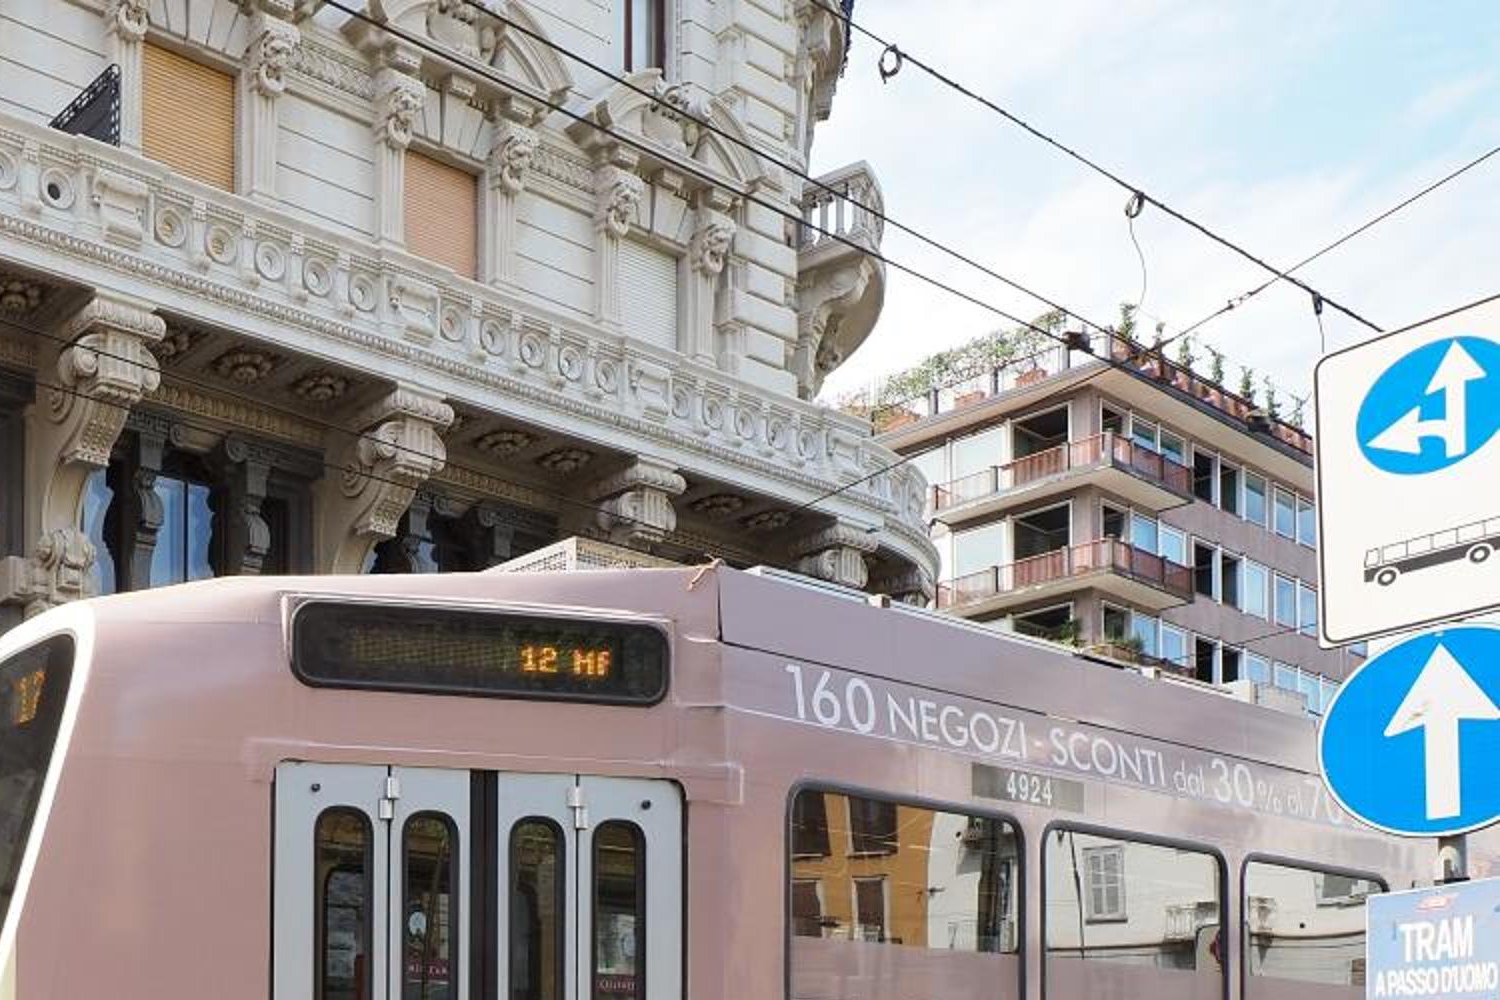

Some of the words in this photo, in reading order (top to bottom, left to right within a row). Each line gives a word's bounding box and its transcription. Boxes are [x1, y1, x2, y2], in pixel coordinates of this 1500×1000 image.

[521, 645, 558, 673] 12
[785, 663, 877, 735] 160
[886, 693, 1028, 761] NEGOZI
[1051, 727, 1166, 787] SCONTI
[1006, 771, 1053, 807] 4924
[1399, 915, 1474, 962] TRAM
[1375, 971, 1386, 997] A
[1387, 967, 1439, 997] PASSO
